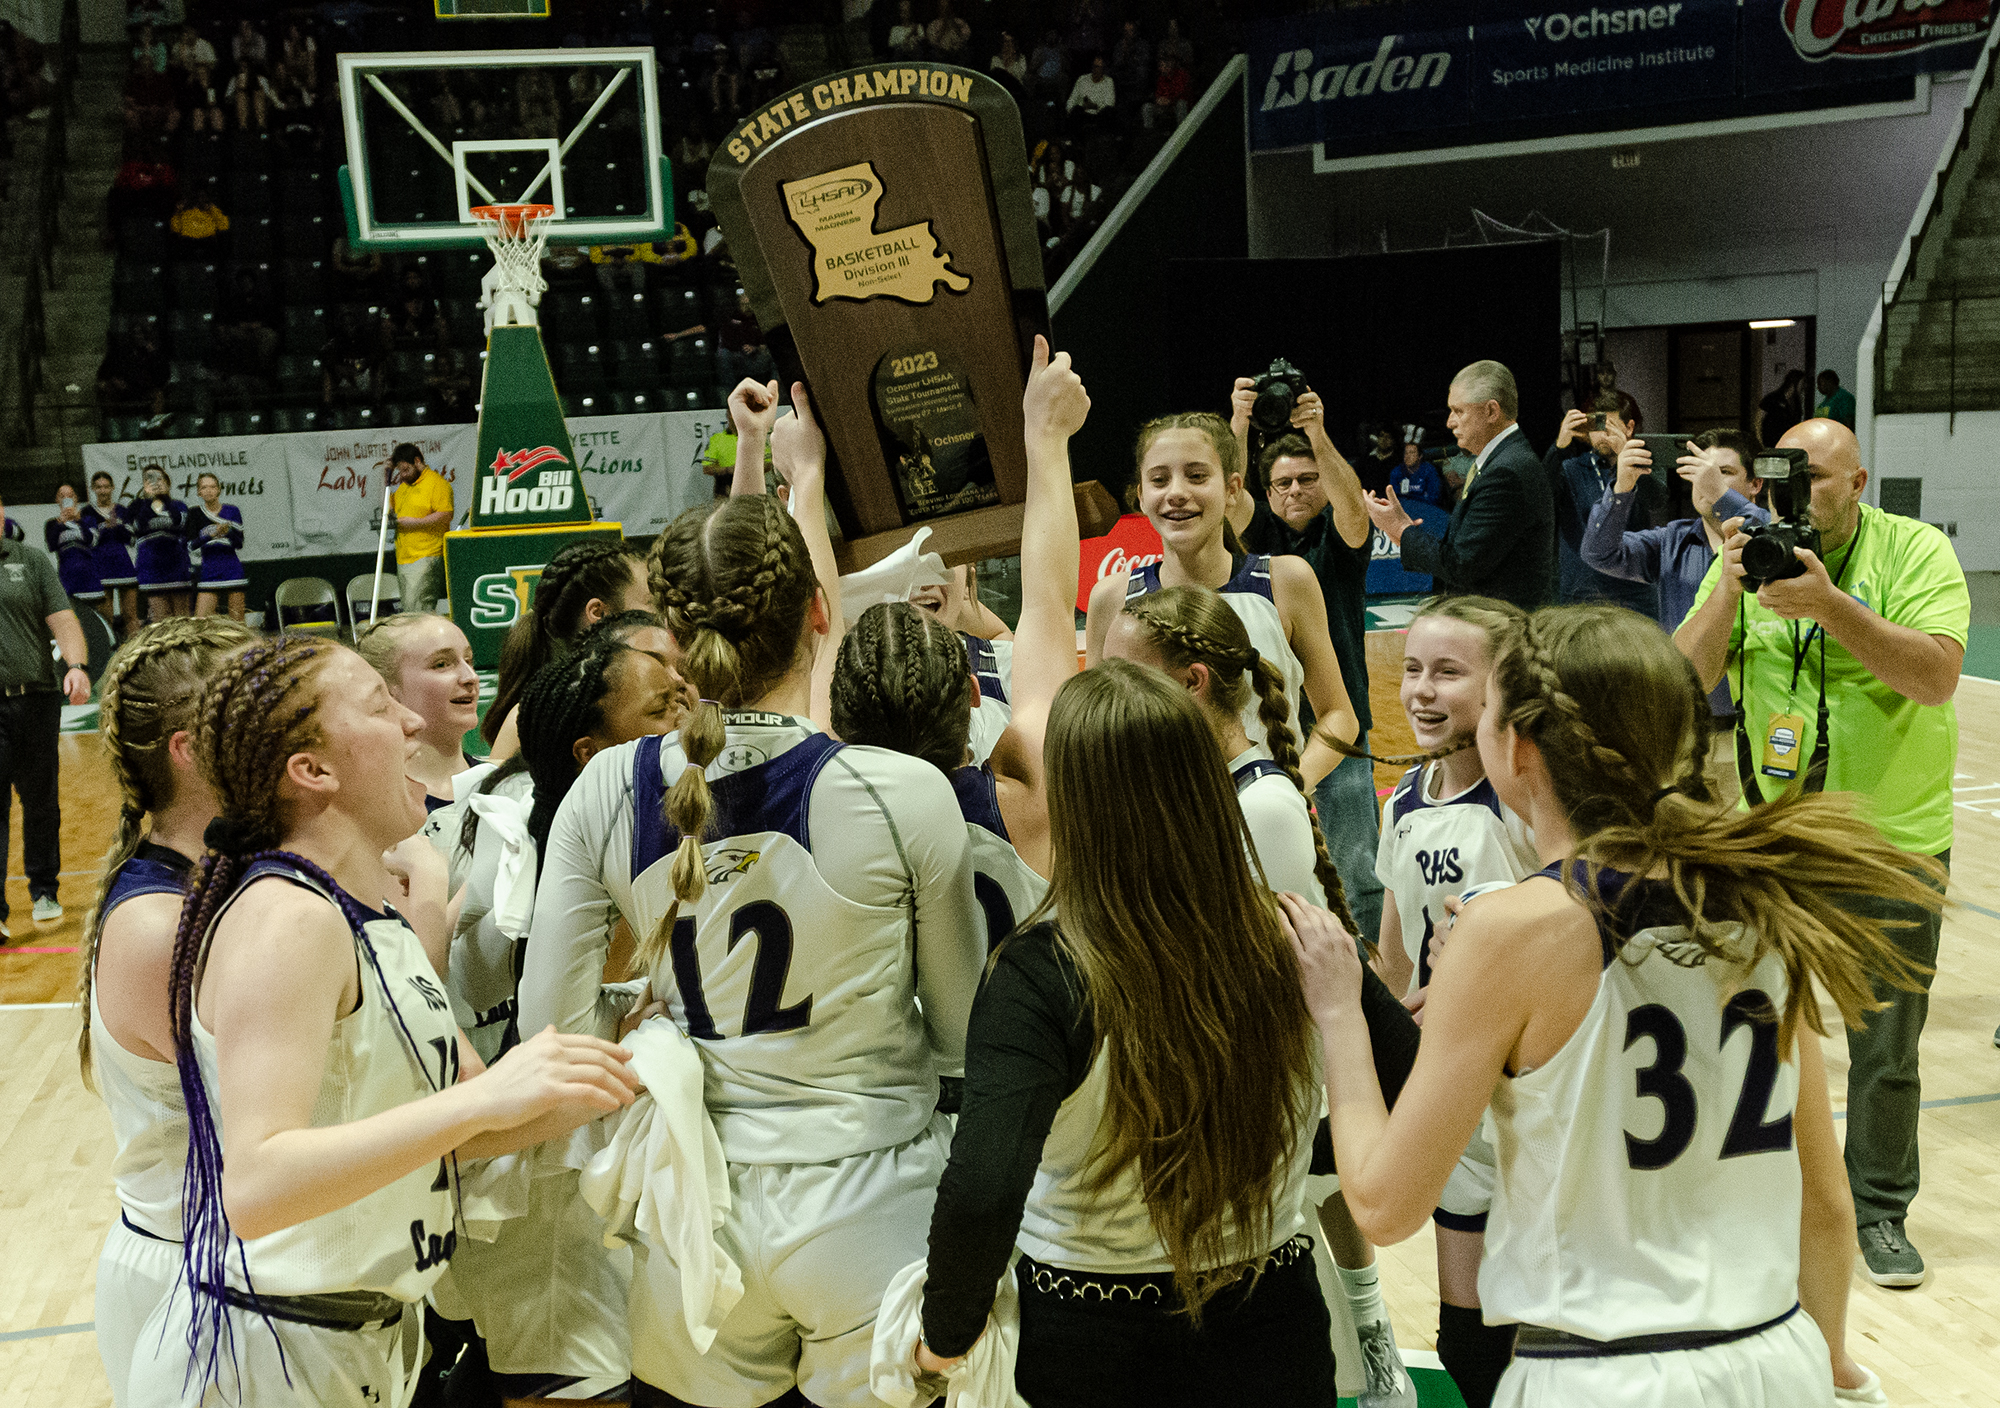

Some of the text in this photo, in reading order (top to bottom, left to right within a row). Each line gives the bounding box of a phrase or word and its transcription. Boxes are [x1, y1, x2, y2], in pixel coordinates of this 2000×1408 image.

[1543, 2, 1683, 42] Ochsner
[1259, 34, 1452, 113] Baden
[1492, 44, 1716, 86] Sports Medicine Institute
[727, 69, 973, 164] STATE CHAMPION
[800, 182, 866, 208] LHSAA
[815, 216, 862, 232] MADNESS
[819, 209, 854, 223] MARSH
[825, 236, 920, 270] BASKETBALL
[843, 261, 896, 281] Division
[857, 271, 902, 288] Non-Select
[890, 350, 939, 378] 2023
[572, 430, 621, 447] YETTE
[581, 449, 643, 475] Lions
[317, 464, 367, 499] Lady
[538, 470, 574, 486] Bill
[721, 712, 783, 726] MOUR
[668, 898, 814, 1042] 12
[1622, 988, 1794, 1172] 32
